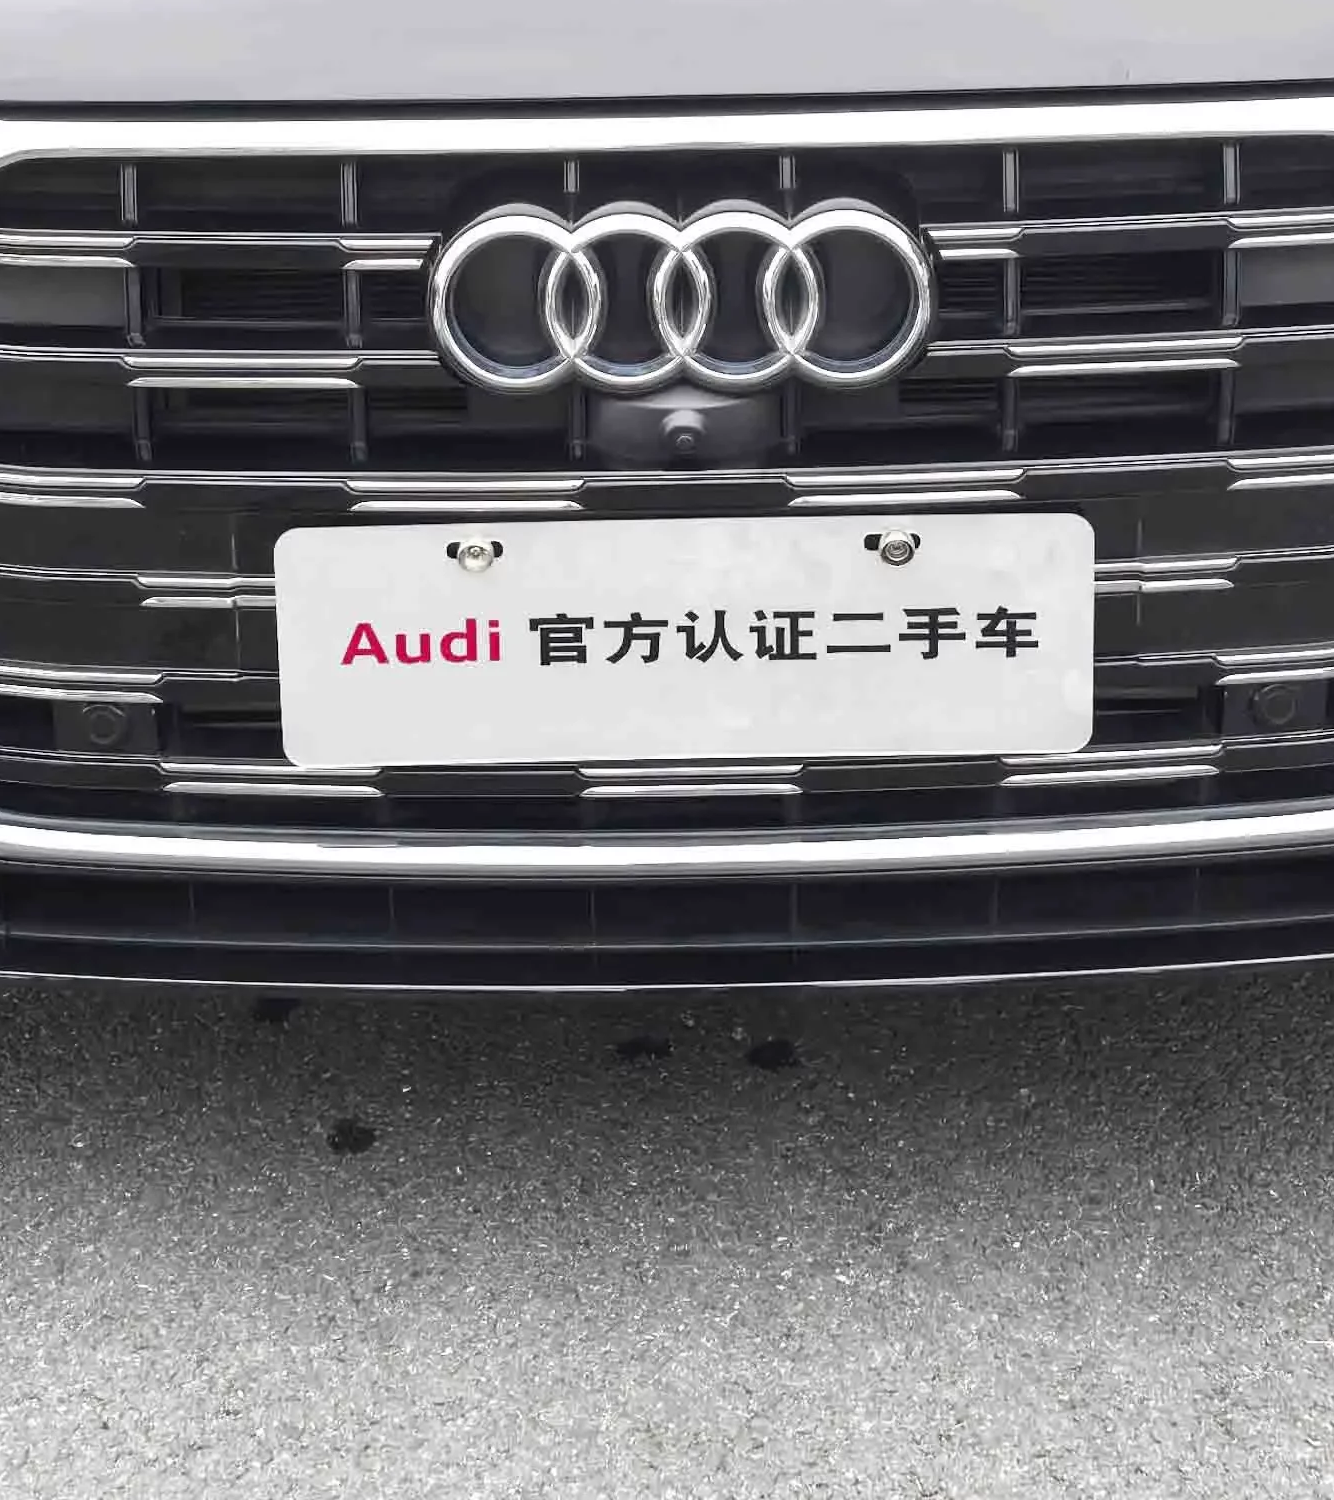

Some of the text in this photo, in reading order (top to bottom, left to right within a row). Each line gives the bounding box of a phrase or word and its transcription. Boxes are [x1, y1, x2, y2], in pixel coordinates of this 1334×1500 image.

[342, 618, 501, 666] Audi
[529, 606, 1039, 666] 官方认证二手车
